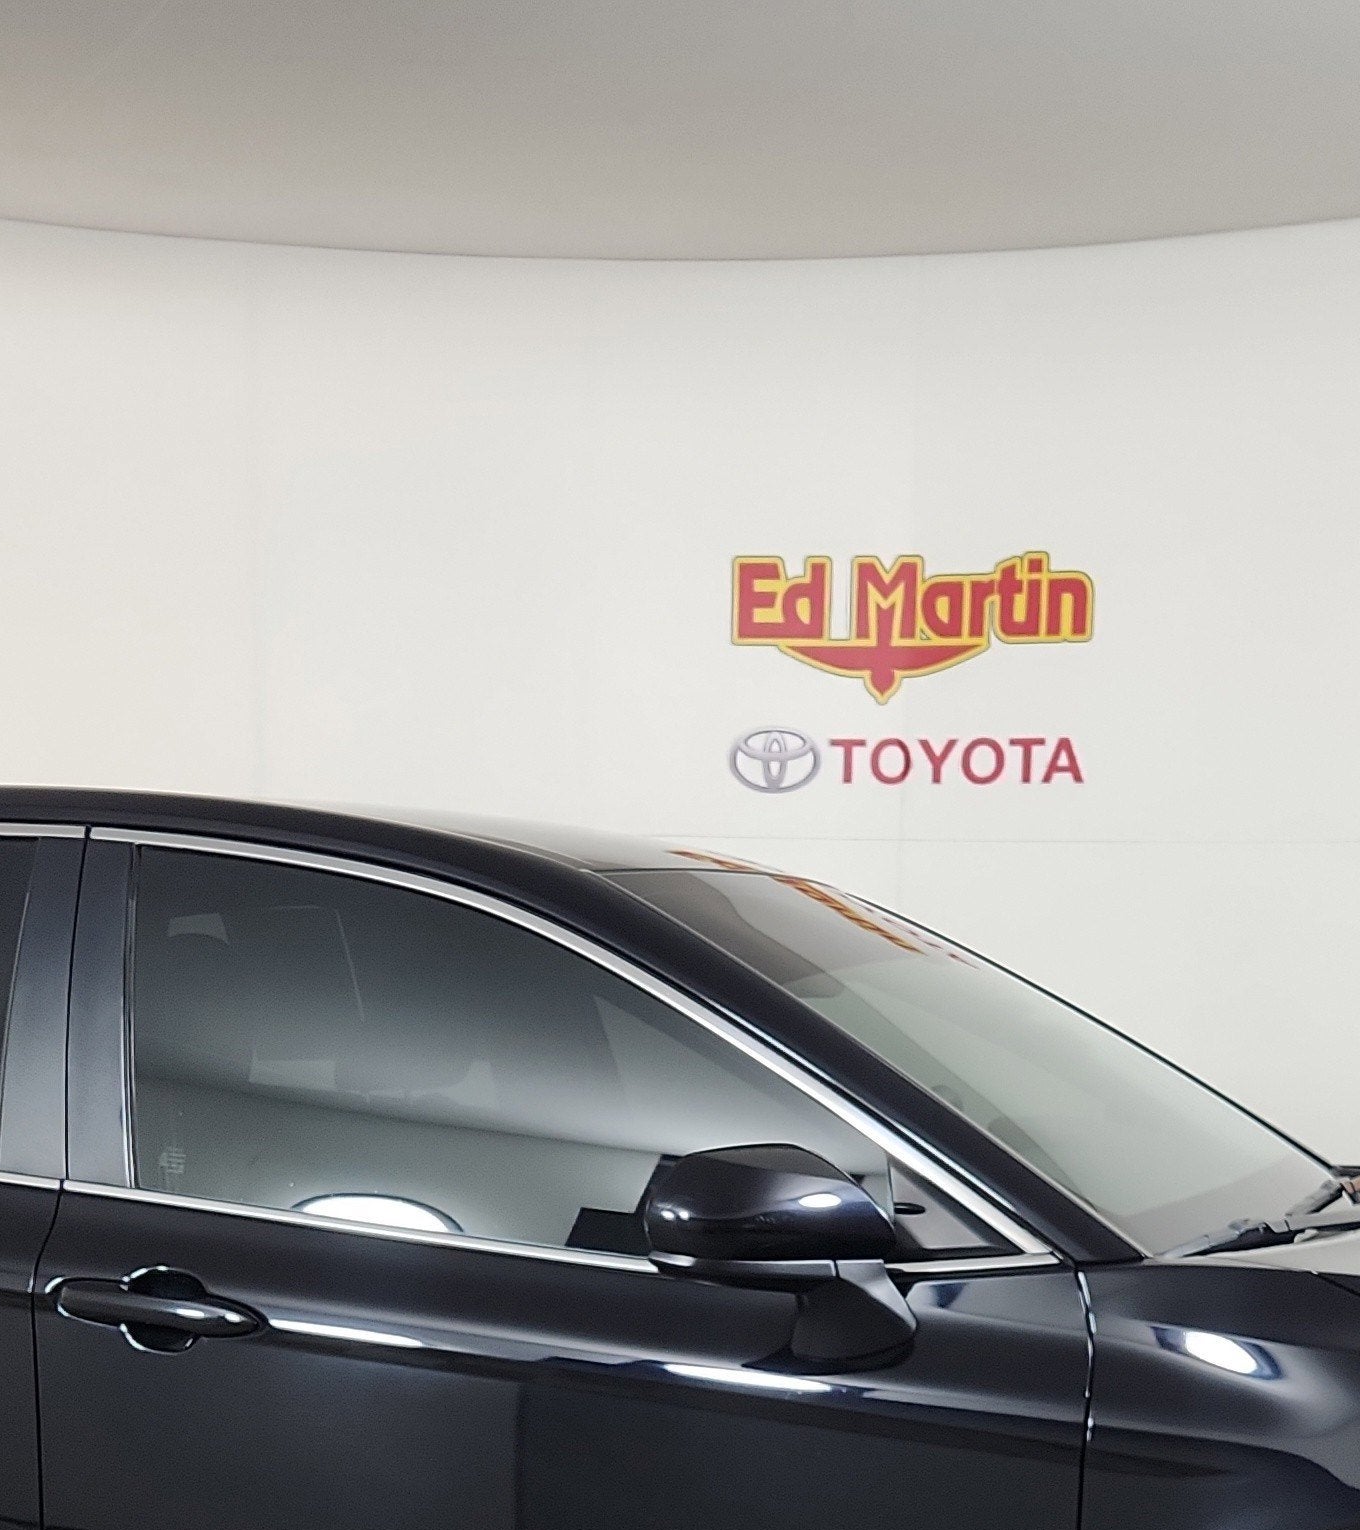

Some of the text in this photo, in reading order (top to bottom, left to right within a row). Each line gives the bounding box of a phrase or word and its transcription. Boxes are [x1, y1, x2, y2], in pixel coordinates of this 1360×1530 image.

[733, 550, 1094, 645] Ed Martin
[830, 736, 1084, 785] TOYOTA
